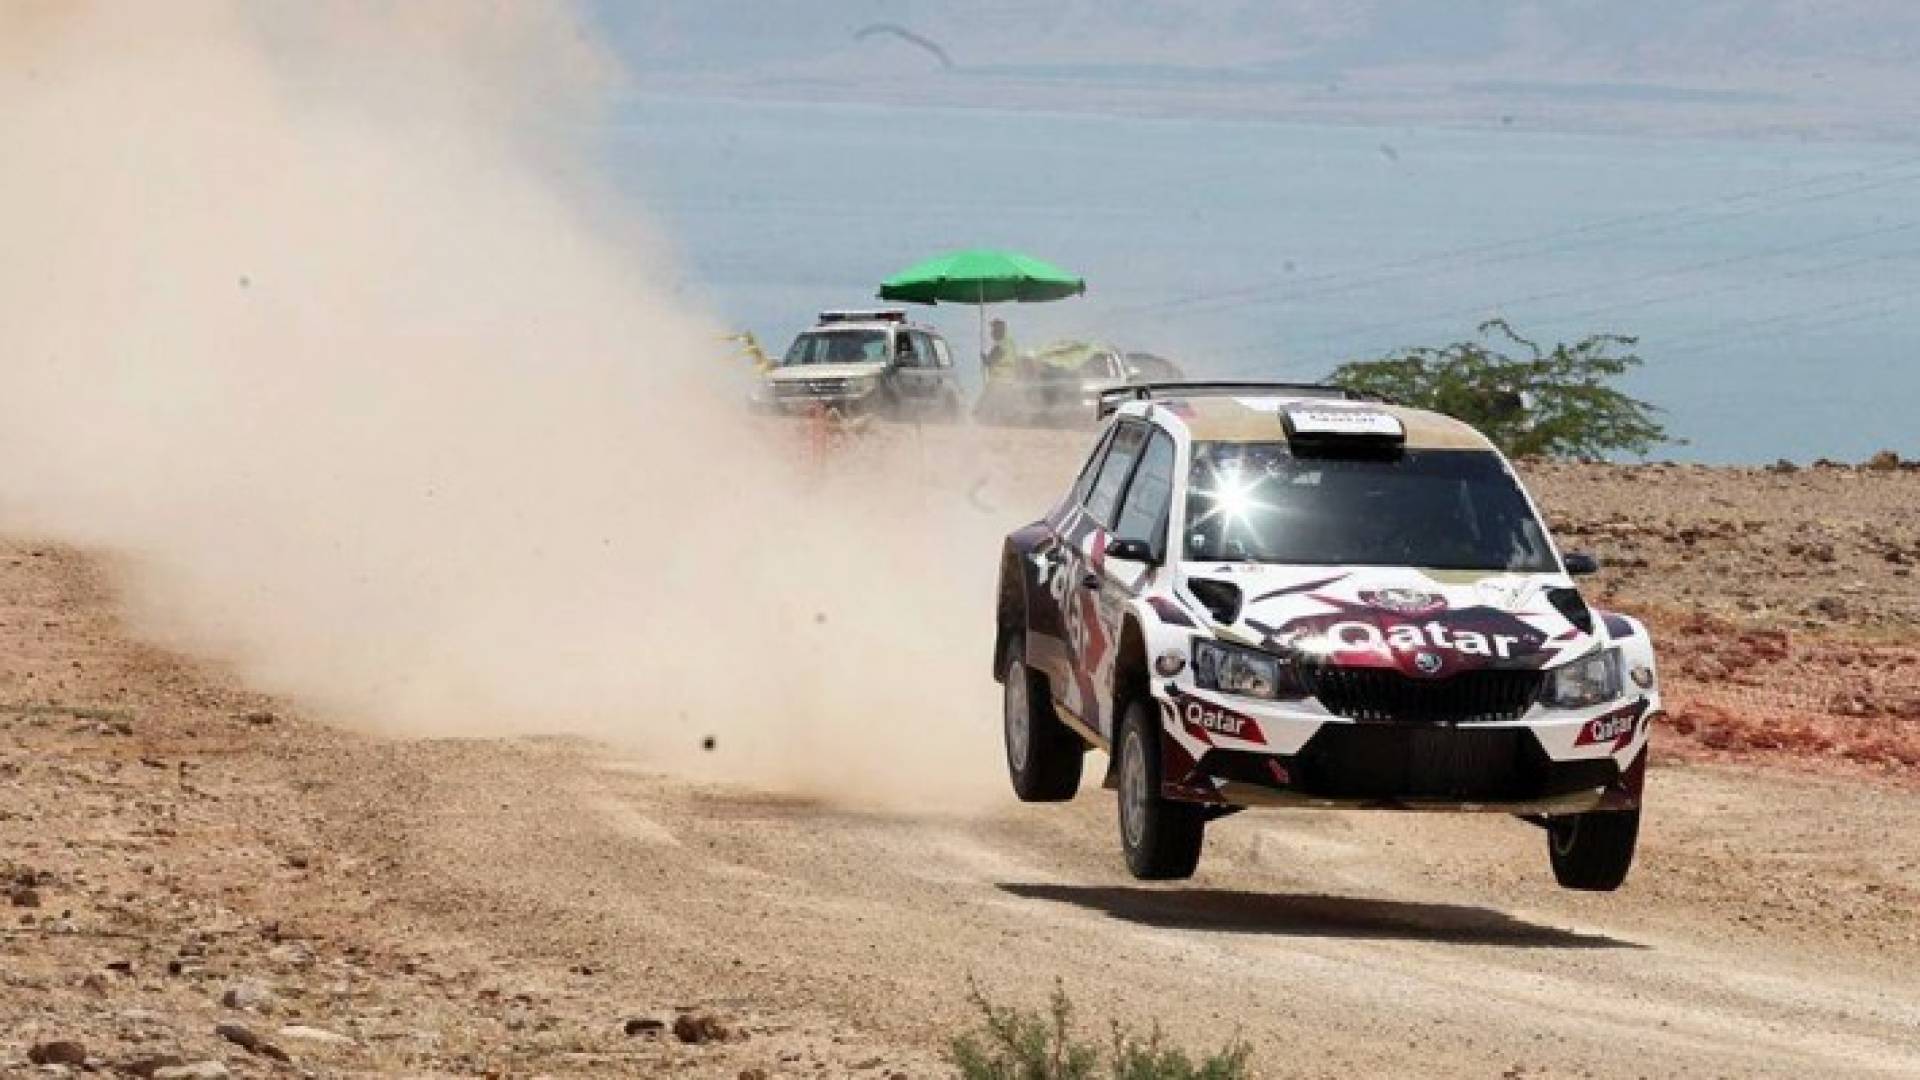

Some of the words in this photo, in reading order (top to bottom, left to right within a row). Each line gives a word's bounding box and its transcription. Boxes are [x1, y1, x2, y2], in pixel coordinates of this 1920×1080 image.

[1327, 620, 1518, 660] Qatar
[1186, 702, 1246, 734] Qatar
[1591, 715, 1635, 740] Qatar
